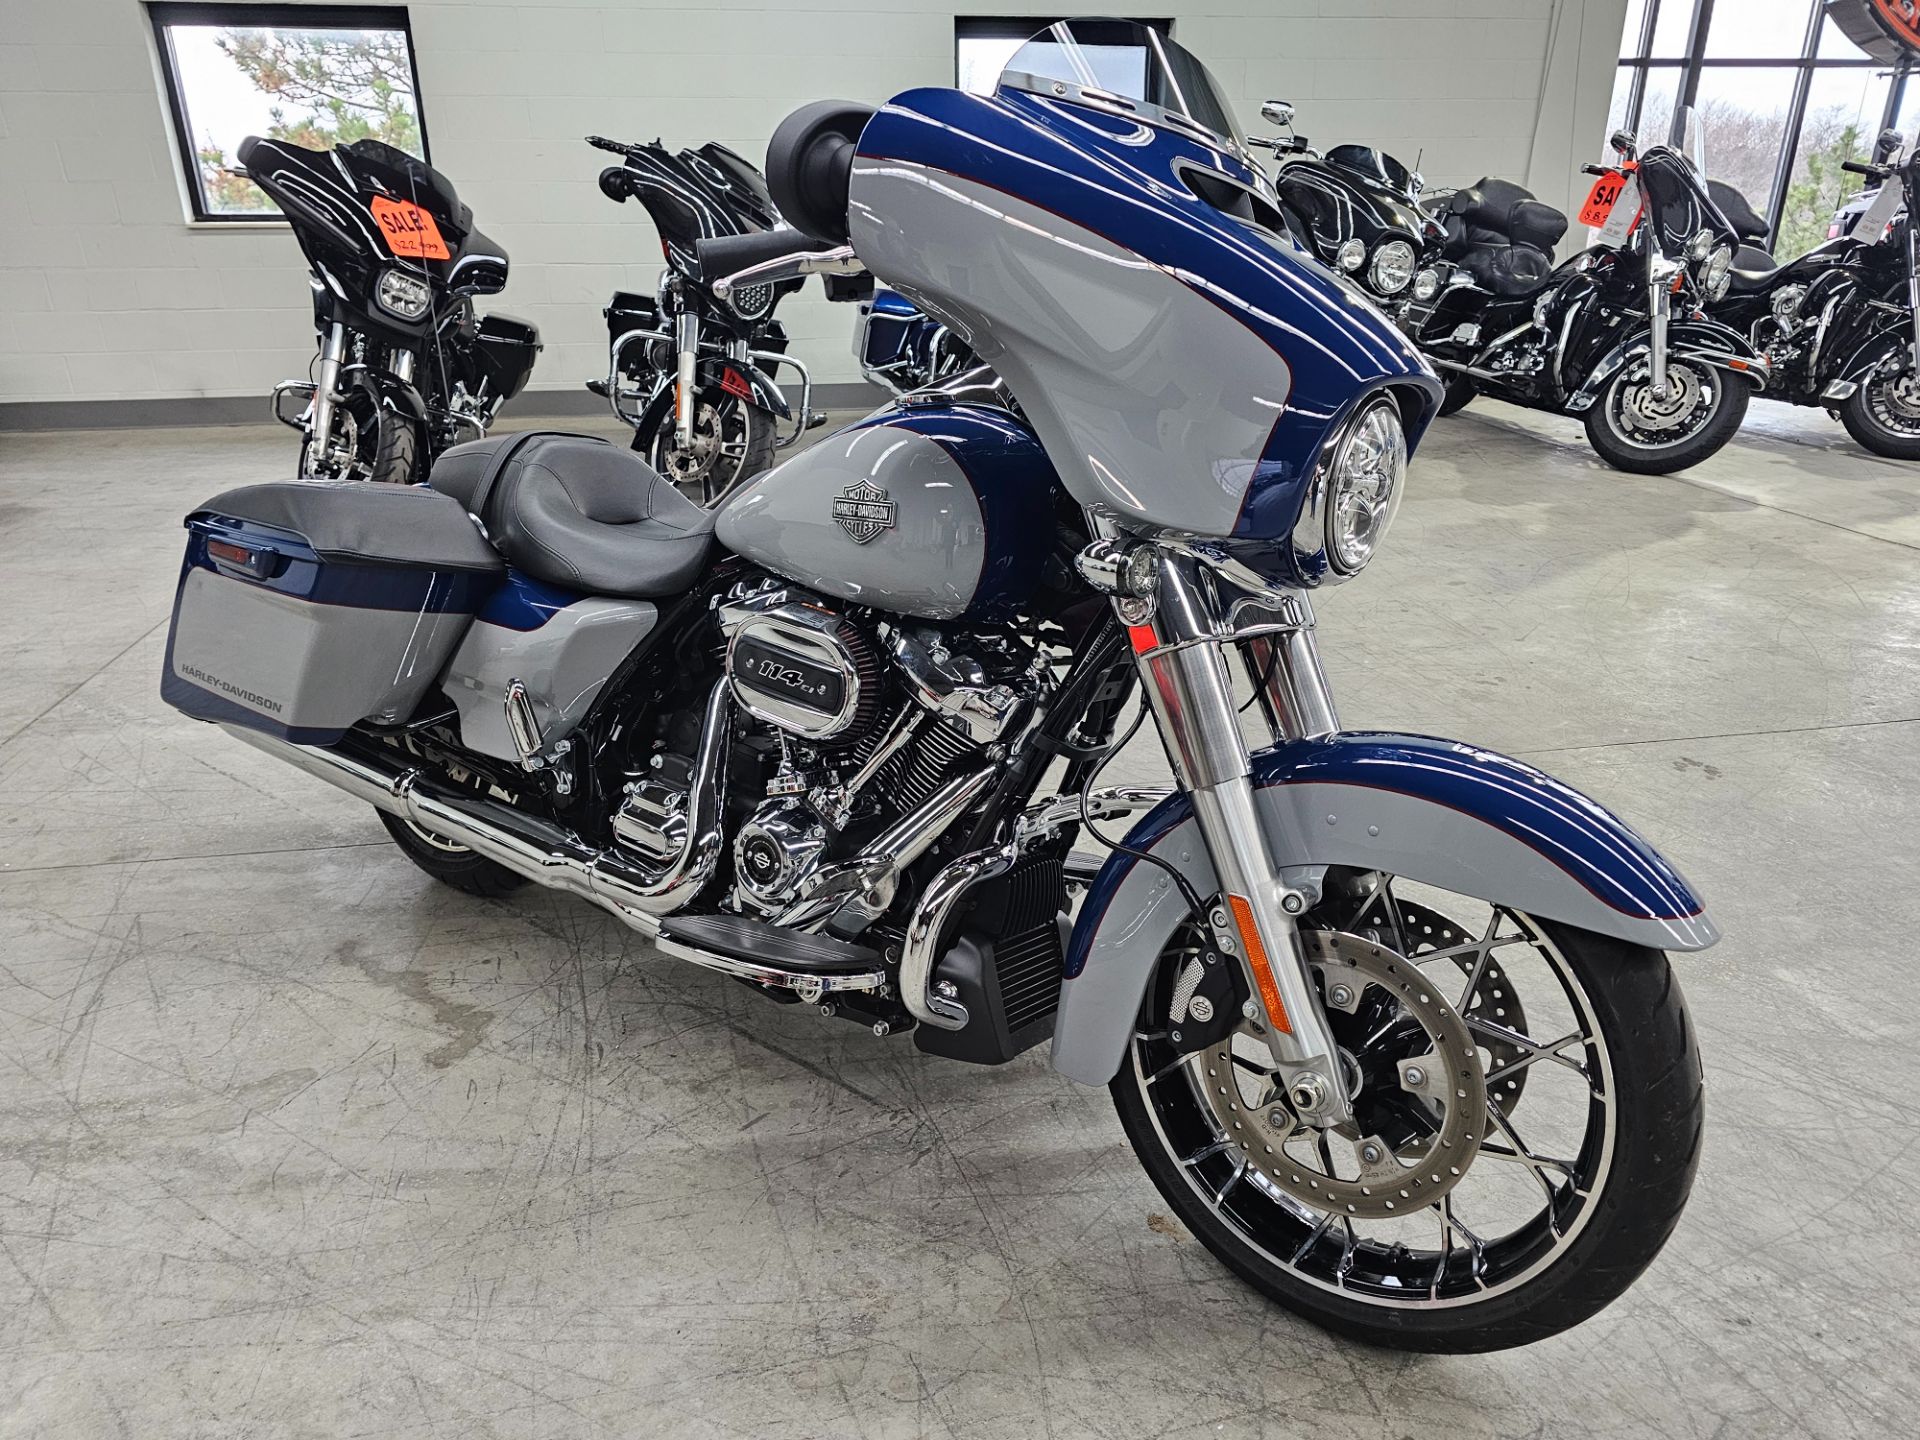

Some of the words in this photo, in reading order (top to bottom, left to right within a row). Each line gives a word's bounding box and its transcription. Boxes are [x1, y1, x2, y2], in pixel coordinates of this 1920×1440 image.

[848, 486, 877, 501] MOTOR
[836, 502, 888, 520] HARLEY-DAVIDSON
[758, 659, 804, 687] 114
[182, 664, 282, 713] HARLEY-DAVIDSON
